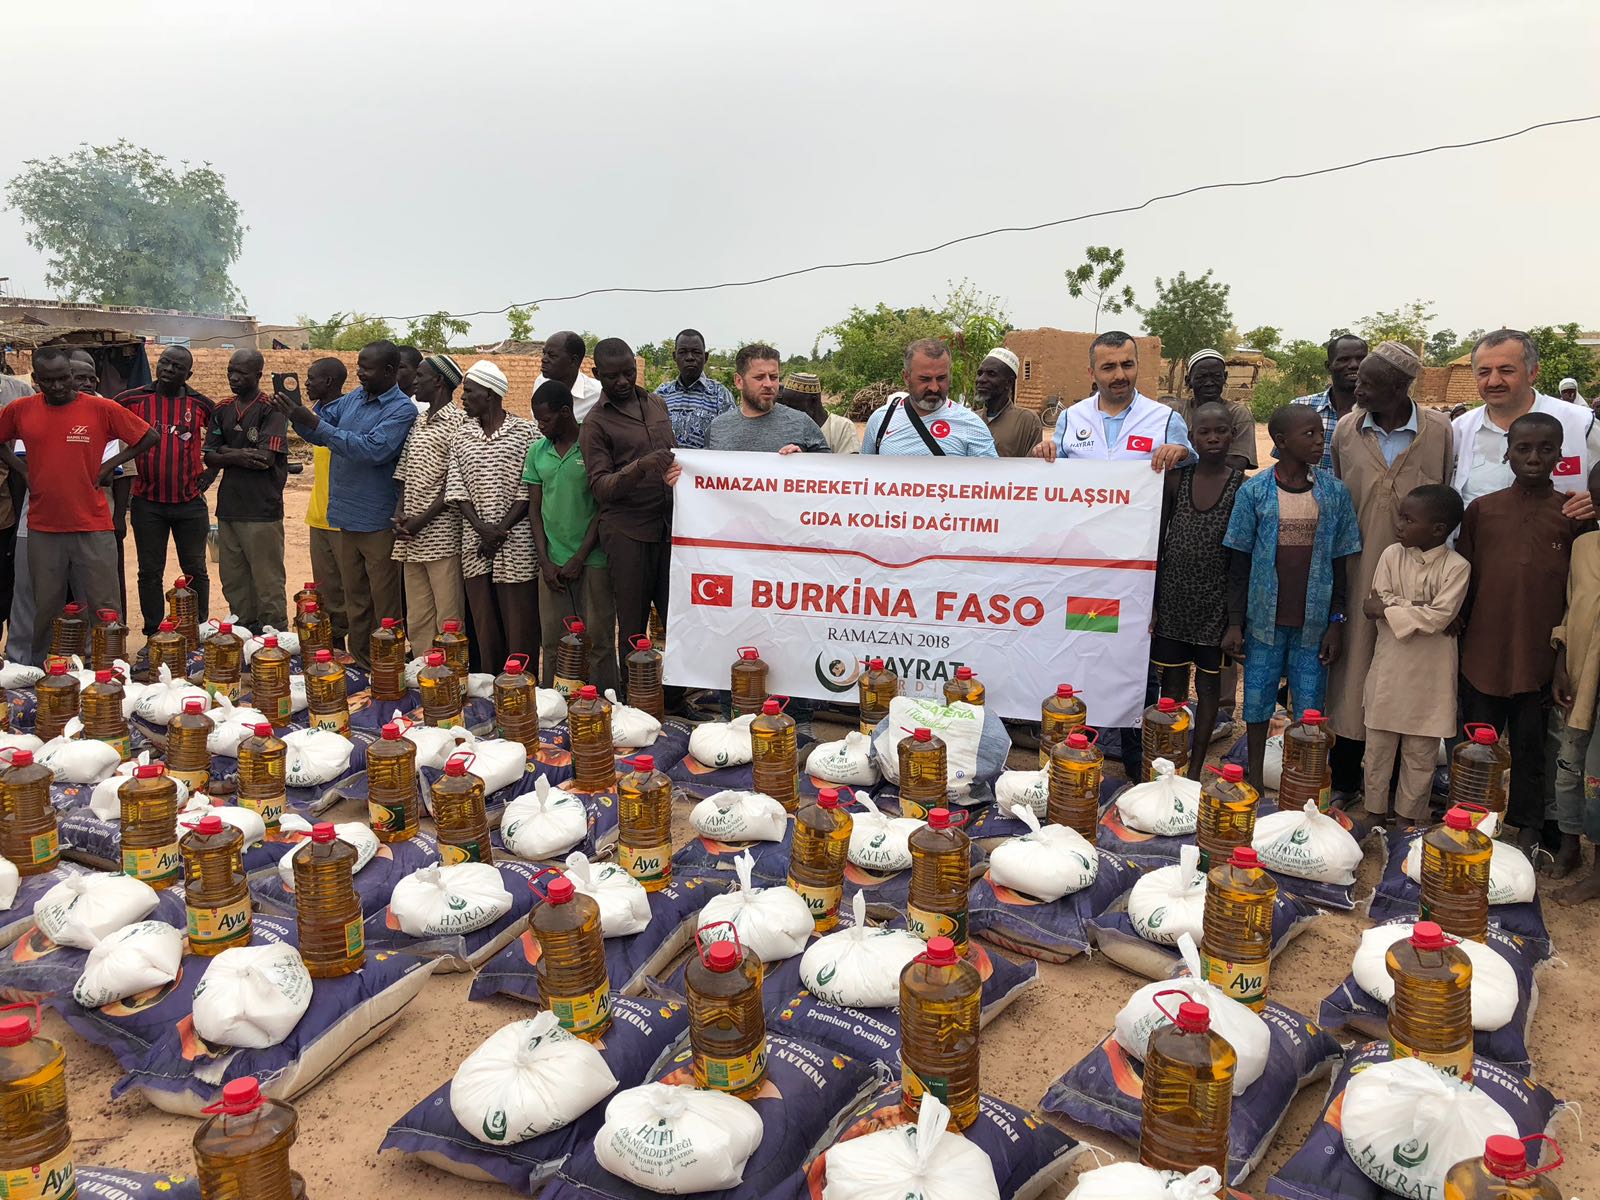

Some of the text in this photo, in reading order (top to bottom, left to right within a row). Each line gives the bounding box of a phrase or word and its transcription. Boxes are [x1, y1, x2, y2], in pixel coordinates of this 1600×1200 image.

[694, 476, 1131, 507] RAMAZAN BEREKETİ KARDEŞLERİMİZE ULAŞSIN
[800, 510, 999, 533] GIDA KOLİSİ DAĞITIMI
[752, 578, 1045, 627] BURKİNA FASO
[827, 627, 951, 649] RAMAZAN 2018
[261, 805, 282, 819] Aya
[62, 822, 110, 838] Premium Quality
[633, 855, 660, 873] Aya
[217, 910, 246, 930] Aya
[1230, 973, 1262, 994] Aya
[596, 991, 611, 1016] Ay
[617, 998, 652, 1017] CHOICE
[613, 1006, 653, 1037] INDIA
[816, 999, 897, 1037] 100% SORTEXED
[1263, 1005, 1300, 1028] CHOIC
[807, 1009, 891, 1050] Premium Quality
[1258, 1010, 1302, 1047] INDIA
[752, 1051, 767, 1074] Ay
[788, 1042, 825, 1068] CHOICE
[775, 1048, 828, 1090] INDIAN
[980, 1103, 1021, 1143] INDIA
[41, 1161, 73, 1196] Aya
[77, 1180, 135, 1200] NDIAN
[99, 1174, 142, 1191] CHOICE
